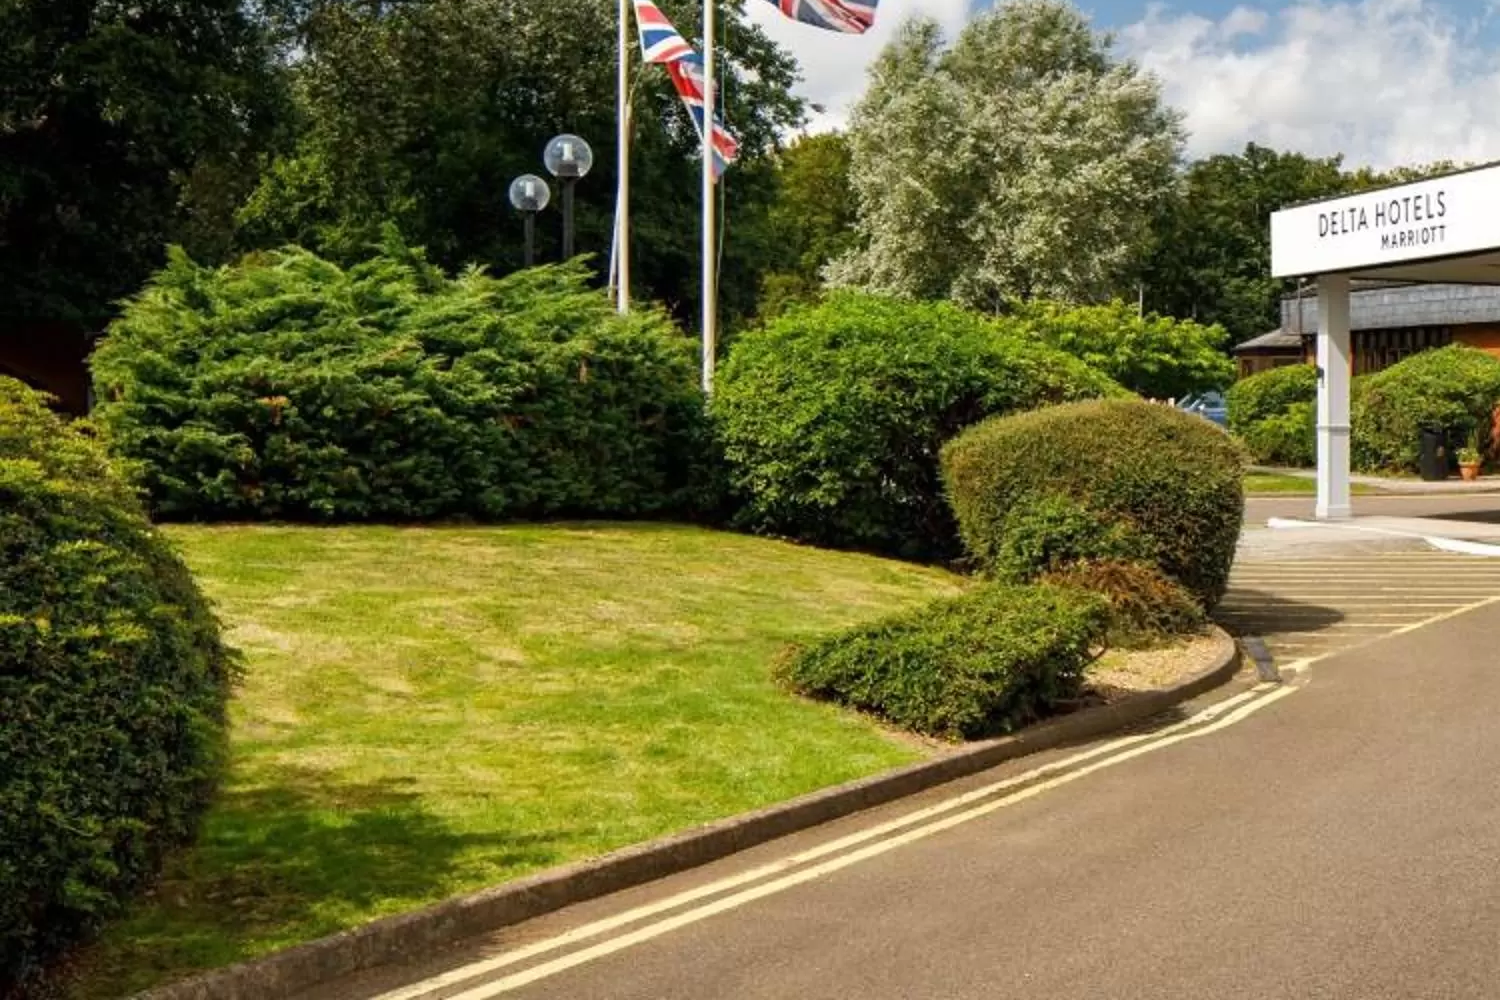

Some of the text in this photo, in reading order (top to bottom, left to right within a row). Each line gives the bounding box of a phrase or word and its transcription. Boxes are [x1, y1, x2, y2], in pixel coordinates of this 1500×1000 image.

[1318, 191, 1446, 237] DELTA HOTELS
[1381, 225, 1446, 249] MARRIOTT
